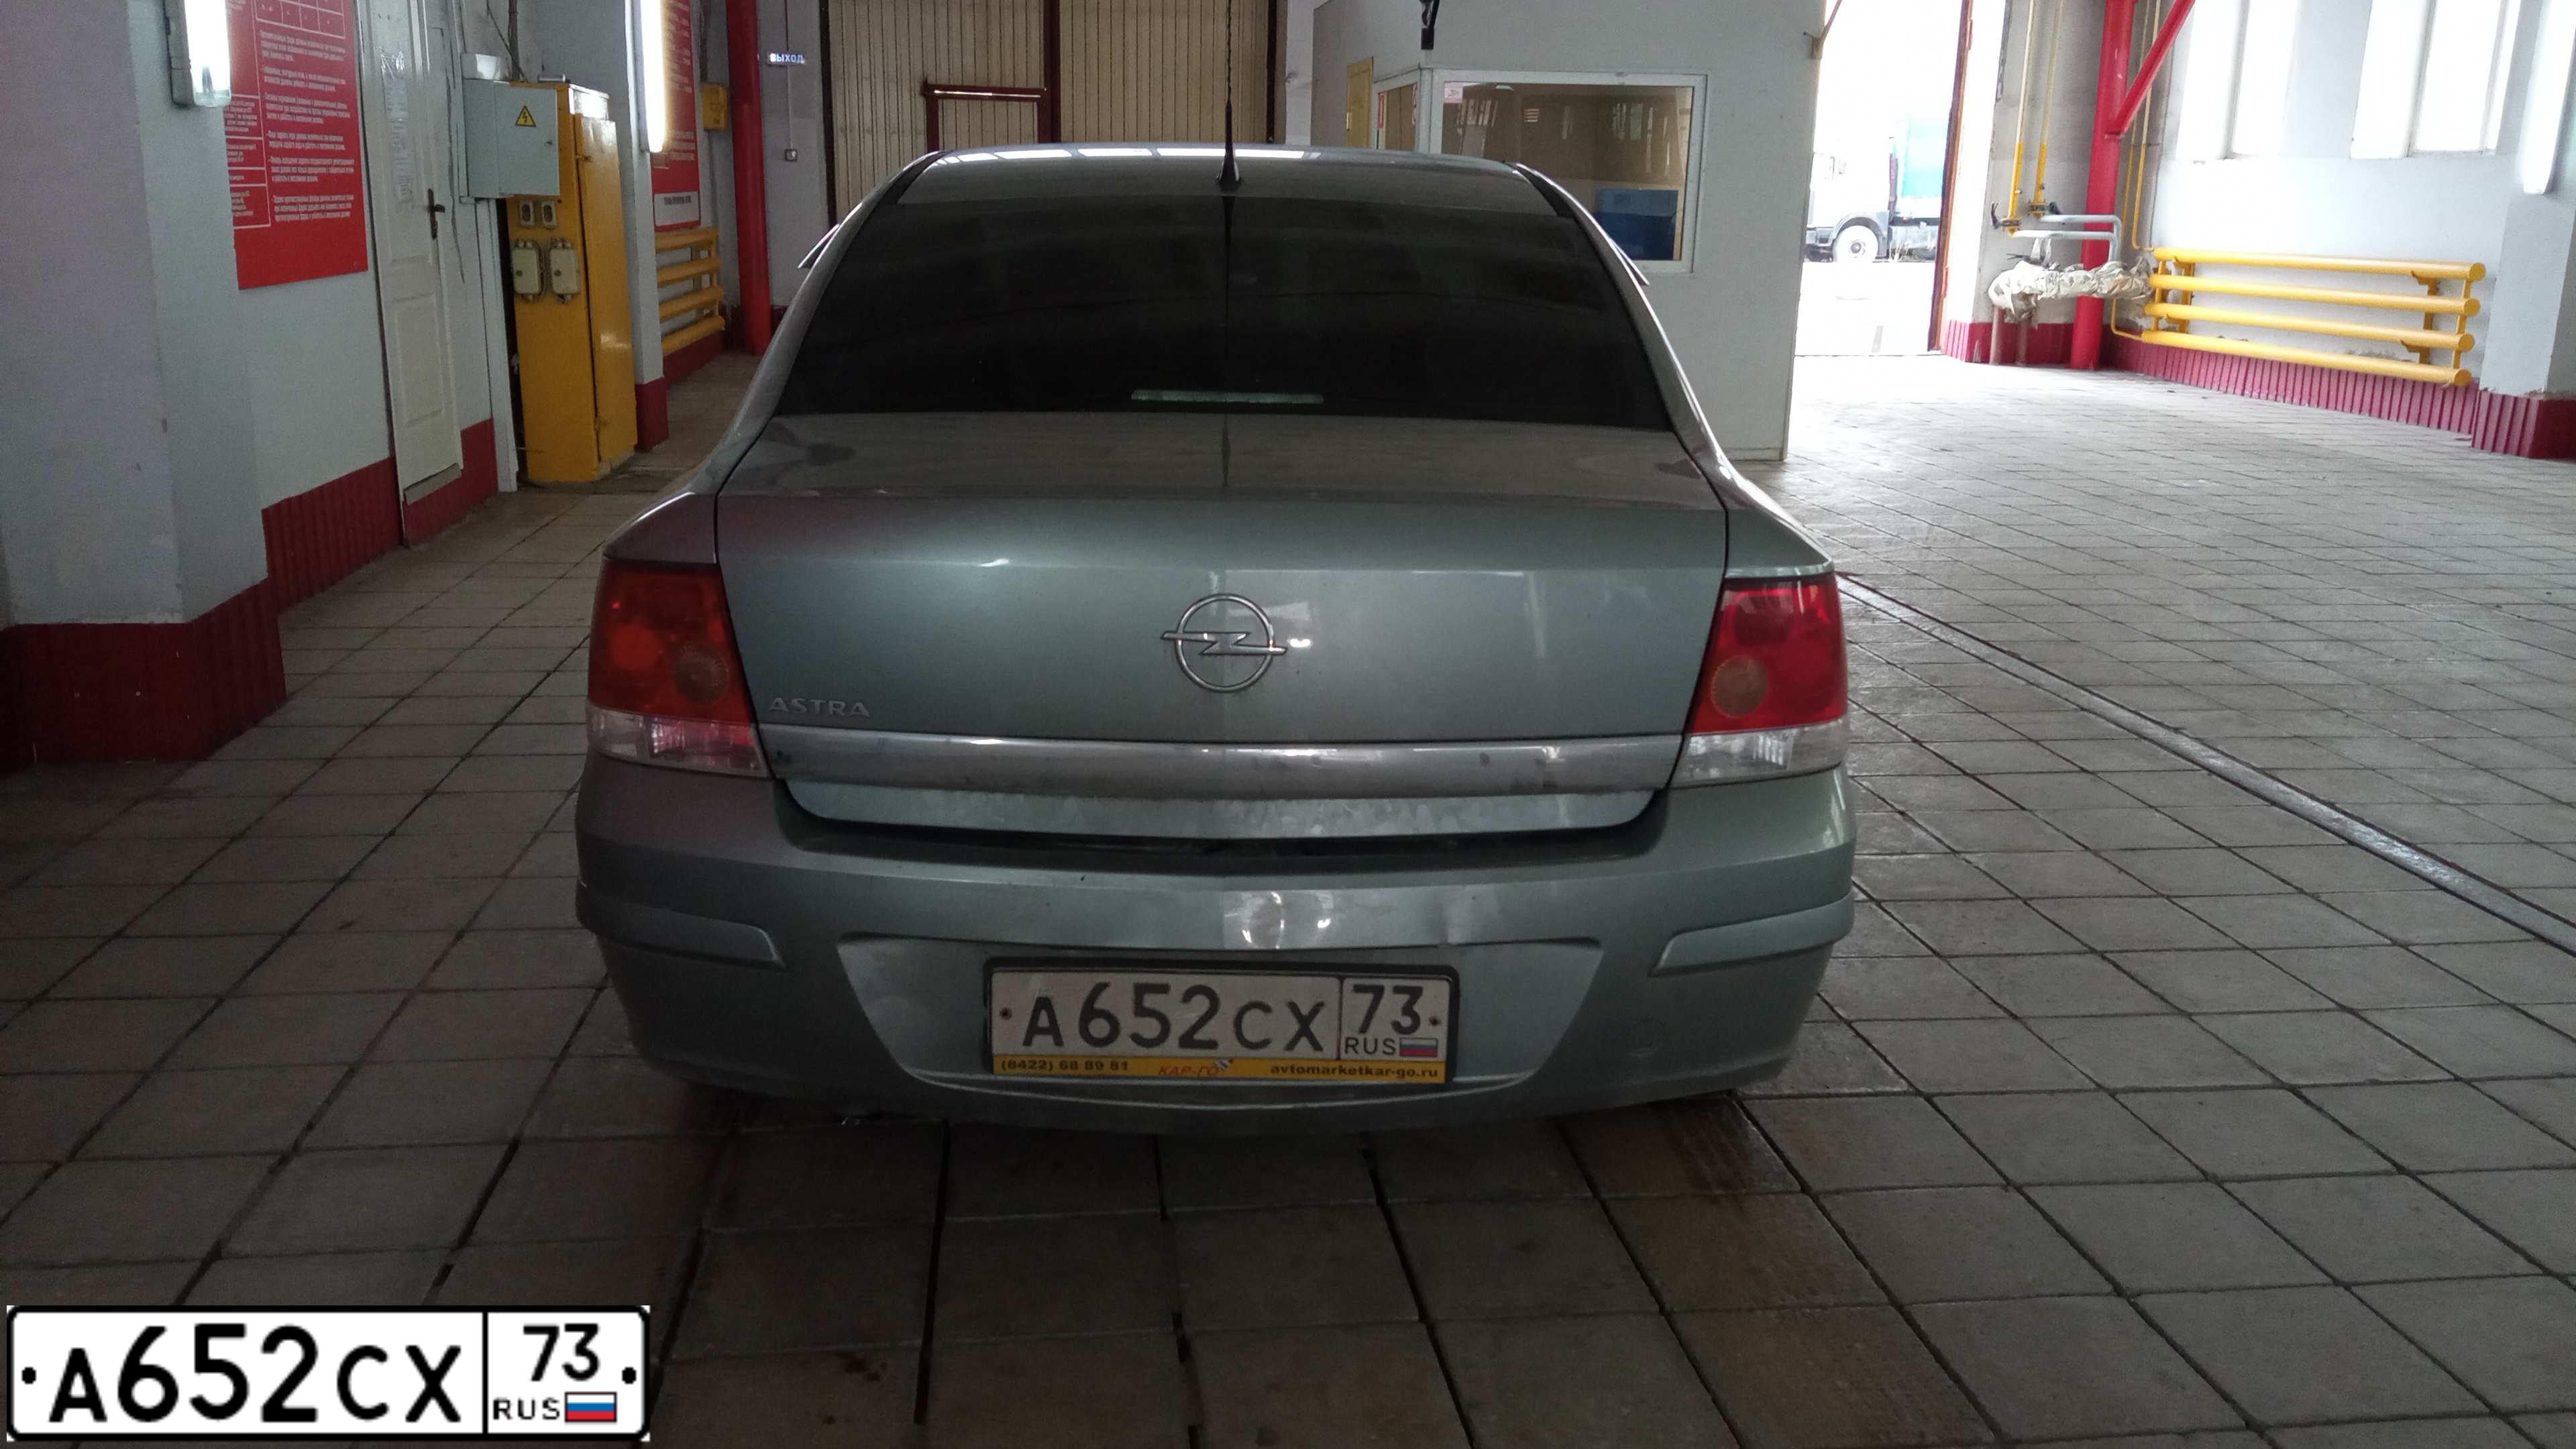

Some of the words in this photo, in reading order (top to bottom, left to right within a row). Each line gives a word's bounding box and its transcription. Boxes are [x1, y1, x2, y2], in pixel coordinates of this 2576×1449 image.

[769, 53, 805, 64] ВЫХОД
[769, 697, 870, 717] ASTRA
[1351, 983, 1424, 1035] 73
[1344, 1036, 1397, 1055] RUS
[1000, 1059, 1053, 1072] (8422)
[1270, 1063, 1438, 1079] avtomarketkar-go.ru
